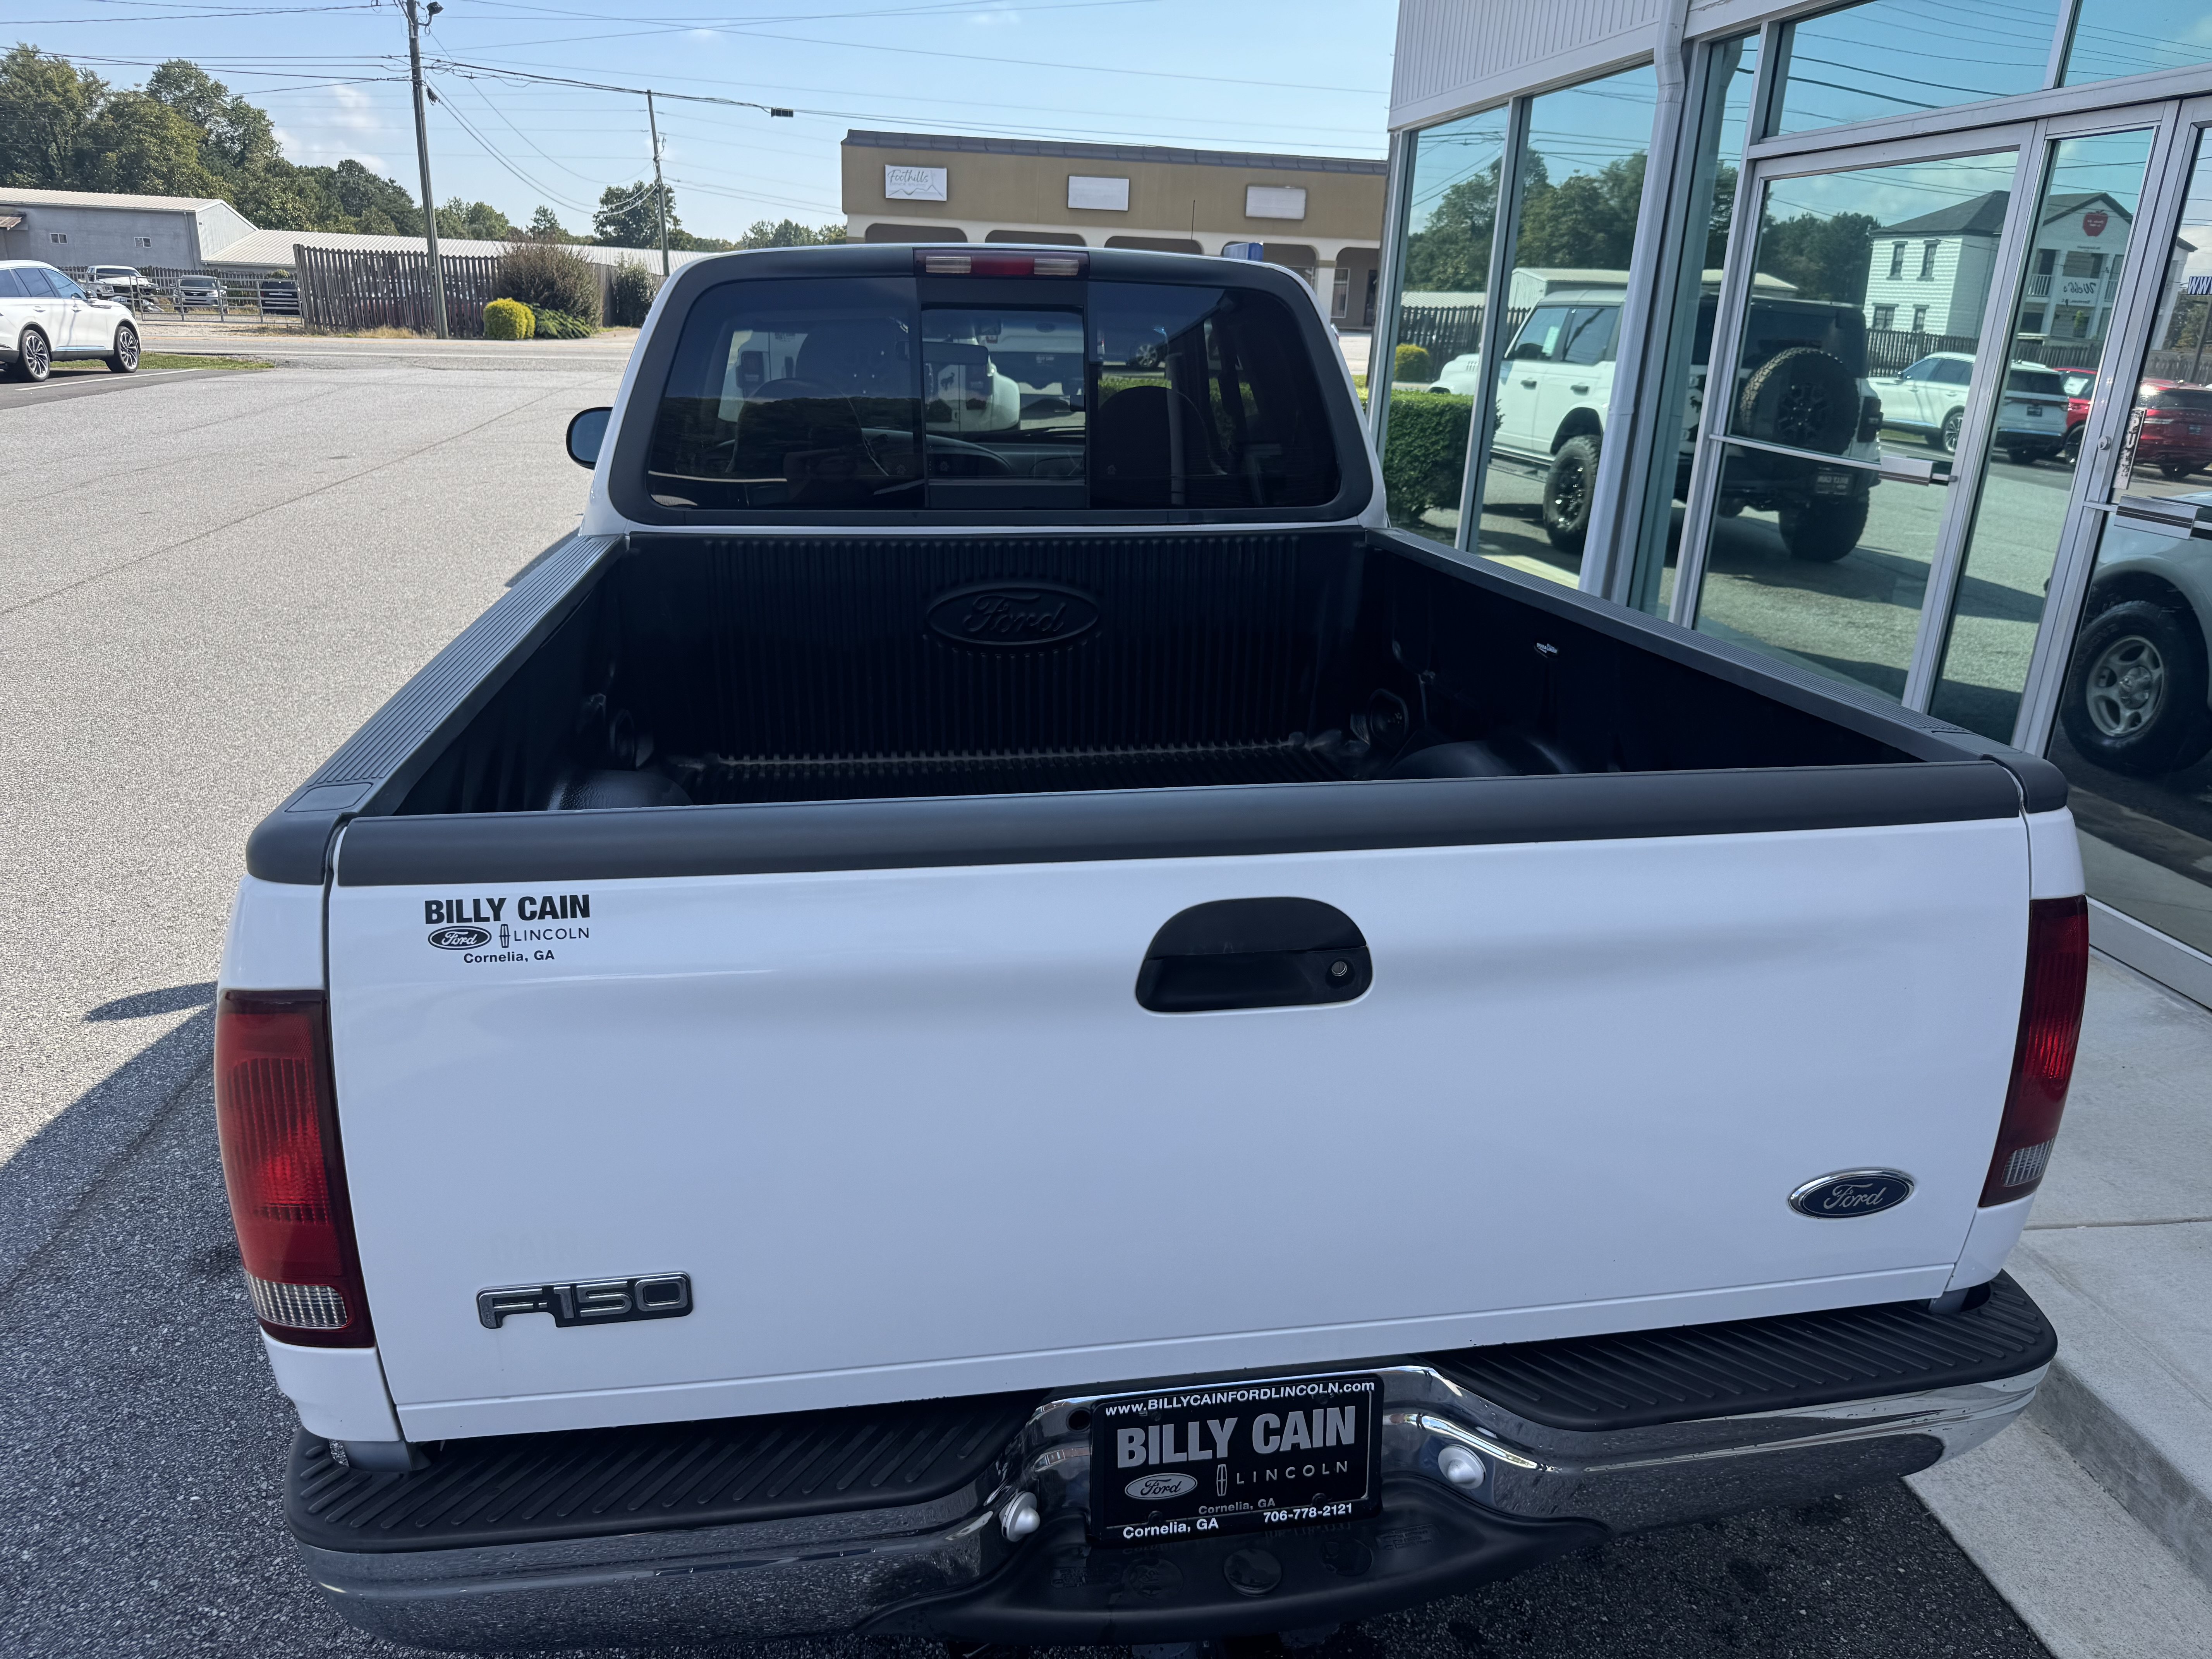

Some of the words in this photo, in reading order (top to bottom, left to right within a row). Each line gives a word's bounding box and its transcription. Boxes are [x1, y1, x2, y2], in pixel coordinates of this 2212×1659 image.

[887, 169, 928, 183] Foothills
[963, 592, 1066, 633] Ford
[425, 897, 507, 924] BILLY
[518, 894, 590, 921] CAIN
[441, 931, 477, 946] Ford
[514, 927, 589, 941] LINCOLN
[464, 951, 529, 963] Cornelia,
[534, 950, 555, 960] GA
[1823, 1183, 1887, 1210] Ford
[478, 1275, 689, 1328] F-150
[1105, 1381, 1375, 1416] www.BILLYCAINFORDLINCOLN.com
[1117, 1417, 1238, 1469] BILLY
[1252, 1405, 1356, 1454] CAIN
[1140, 1474, 1181, 1496] Ford
[1236, 1460, 1348, 1484] LINCOLN
[1198, 1500, 1254, 1515] Cornelia,
[1258, 1498, 1276, 1508] GA
[1263, 1503, 1353, 1524] 706-778-2121
[1123, 1522, 1191, 1539] Cornelia,
[1196, 1518, 1219, 1530] GA
